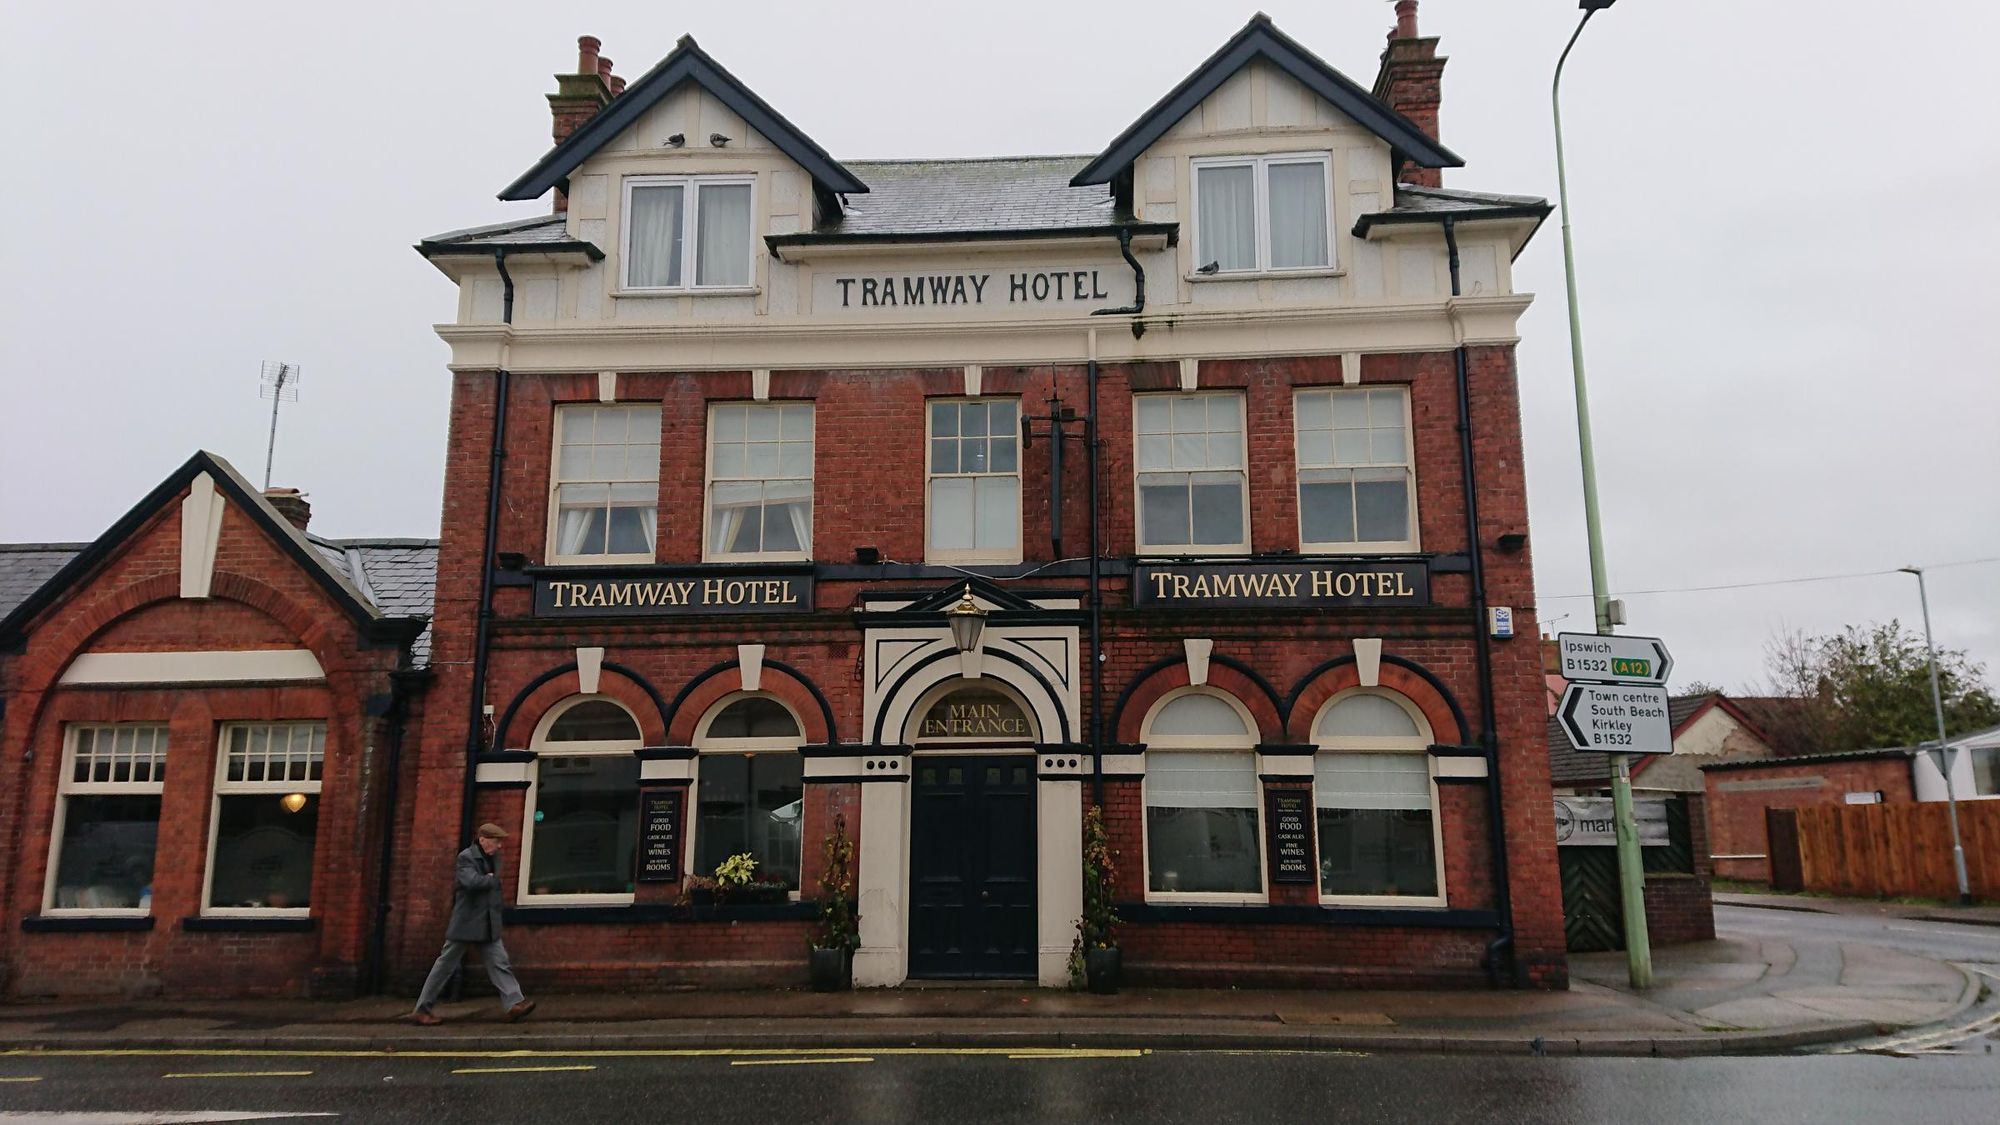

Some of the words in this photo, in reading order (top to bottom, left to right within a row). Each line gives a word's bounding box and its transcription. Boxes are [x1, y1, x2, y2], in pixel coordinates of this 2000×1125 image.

[836, 274, 990, 307] TRAMWAY
[1009, 271, 1108, 302] HOTEL
[1150, 572, 1302, 598] TRAMWAY
[1310, 570, 1414, 597] HOTEL
[549, 582, 695, 607] TRAMWAY
[702, 579, 797, 605] HOTEL
[1564, 640, 1611, 653] Ipswich
[1567, 658, 1607, 672] B1532
[1613, 659, 1649, 676] (A12)
[1588, 690, 1619, 702] Town
[1623, 692, 1659, 703] centre
[949, 704, 1000, 718] MAIN
[1591, 704, 1626, 716] South
[1630, 706, 1665, 718] Beach
[925, 718, 1025, 733] ENTRANCE
[1592, 719, 1632, 732] Kirkley
[1594, 733, 1632, 745] B1532
[650, 823, 672, 831] FOOD
[1280, 822, 1302, 830] FOOD
